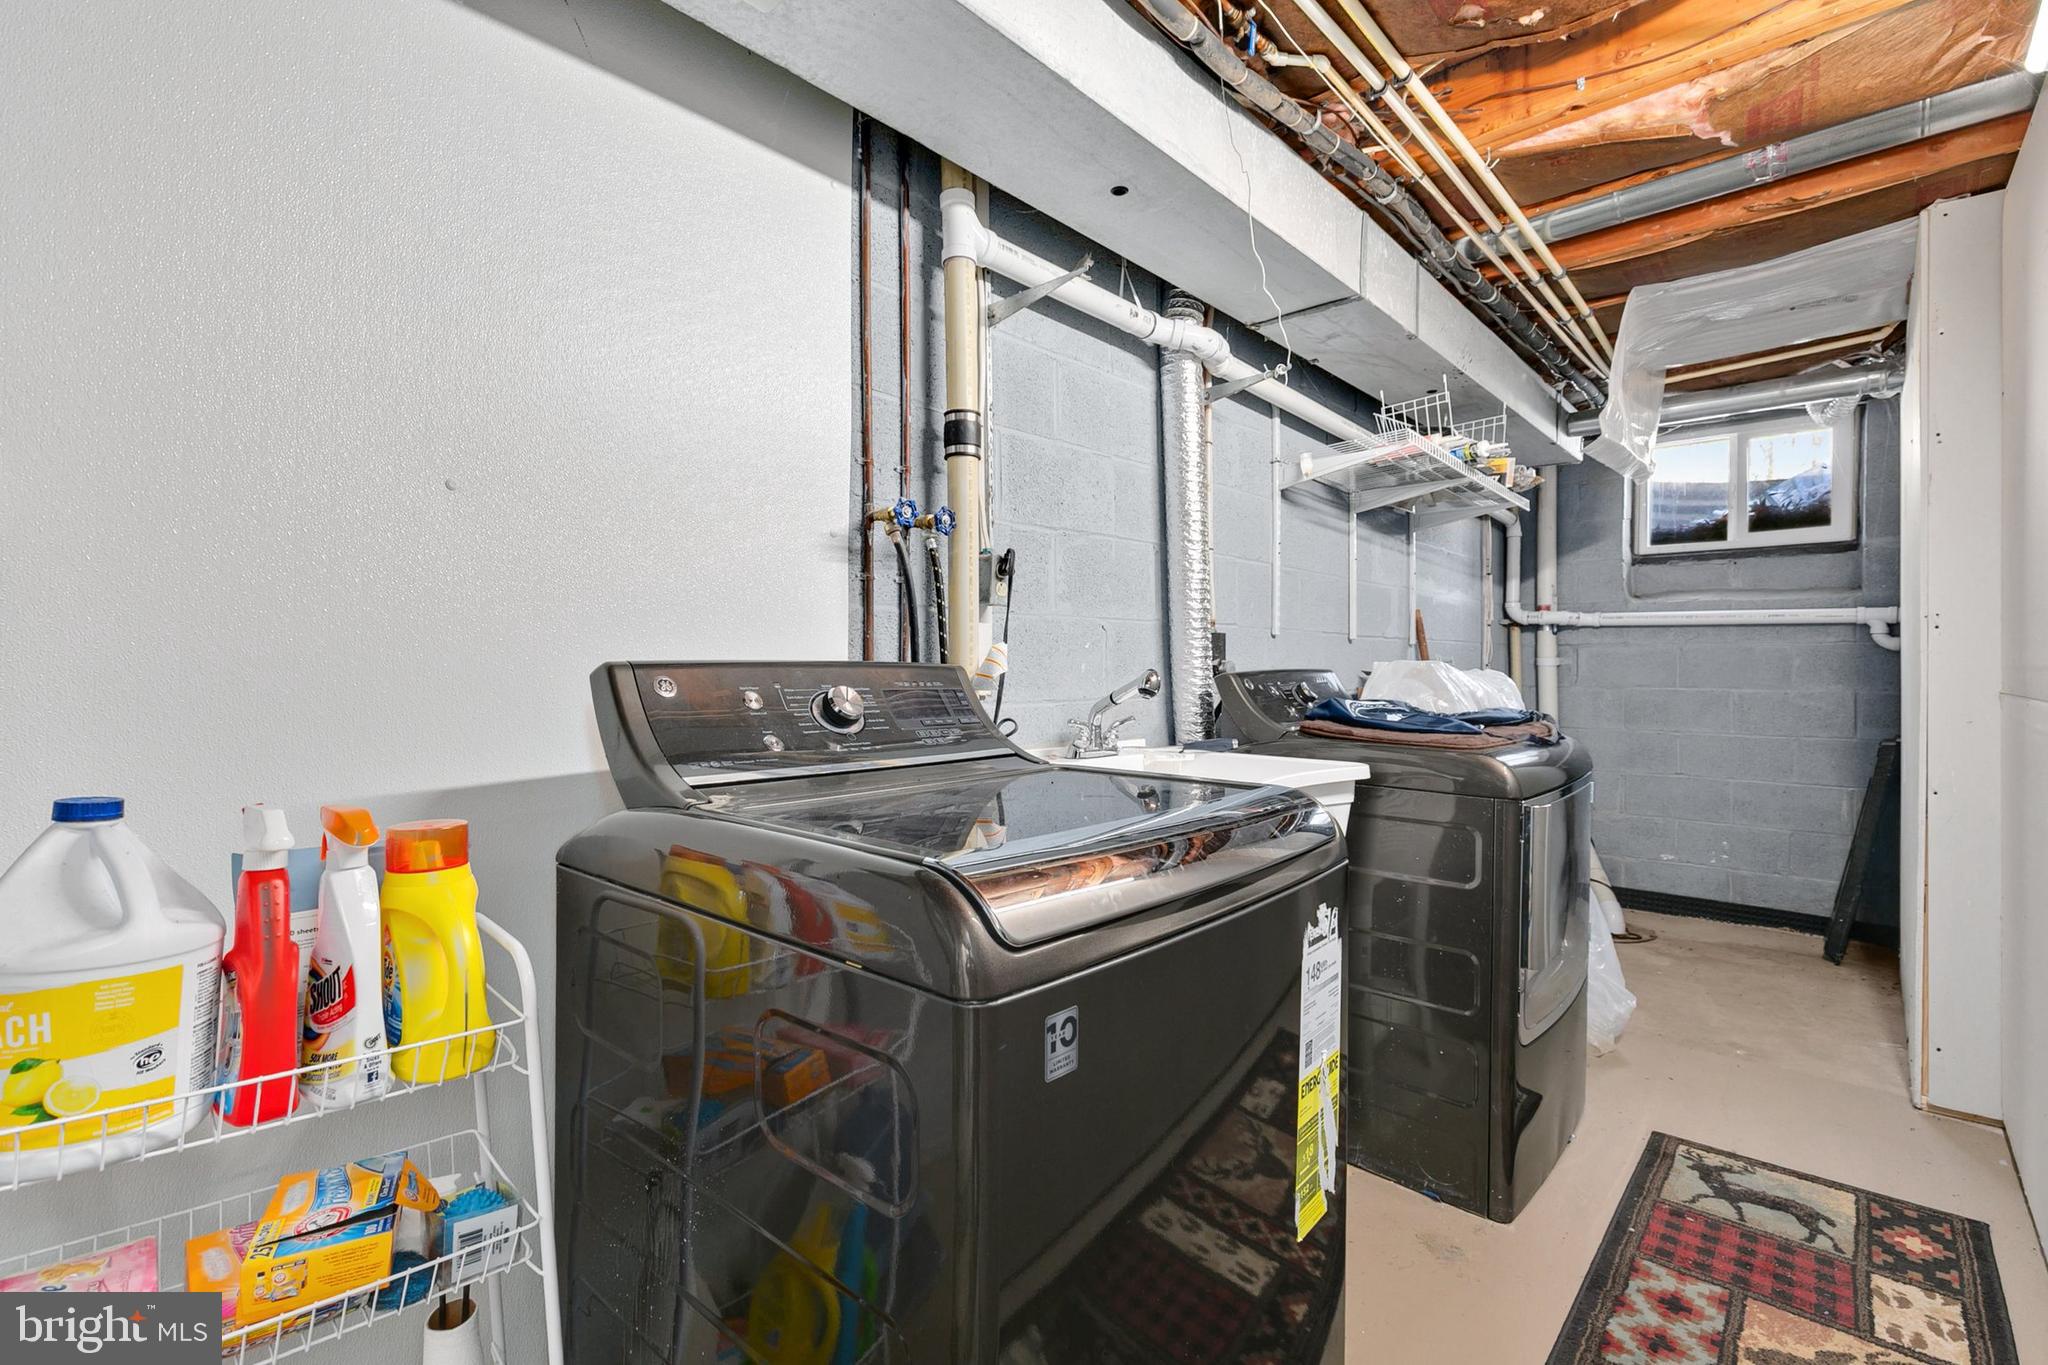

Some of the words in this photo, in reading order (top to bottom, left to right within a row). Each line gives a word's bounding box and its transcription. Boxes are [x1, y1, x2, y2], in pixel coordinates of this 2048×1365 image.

[310, 965, 342, 1013] SHOUT
[1306, 961, 1321, 991] 148
[0, 1012, 52, 1048] CH
[1047, 1015, 1077, 1054] 10
